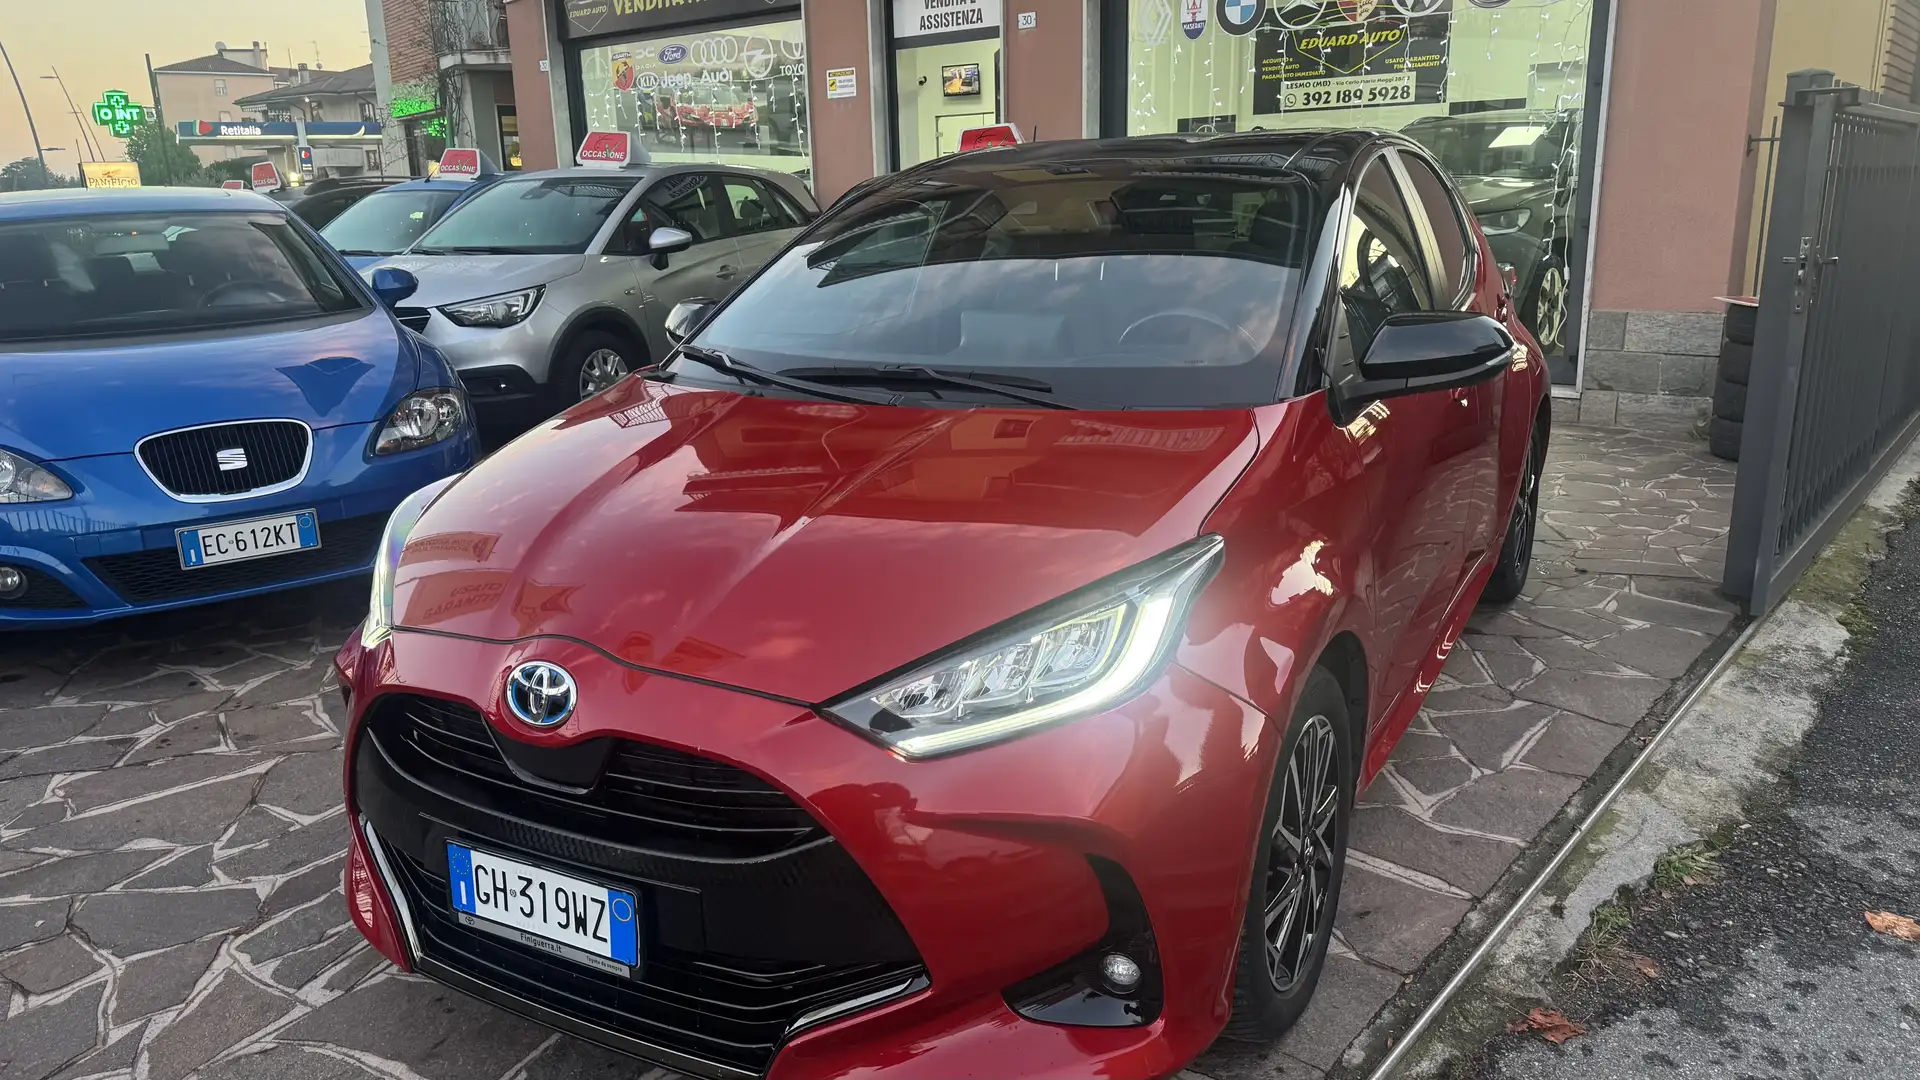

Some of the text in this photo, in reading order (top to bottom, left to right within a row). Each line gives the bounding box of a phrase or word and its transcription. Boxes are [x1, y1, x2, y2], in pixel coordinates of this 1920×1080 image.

[569, 5, 607, 18] EDUARD AUTO
[920, 8, 983, 31] ASSISTENZA
[1022, 15, 1032, 26] 30
[1183, 22, 1205, 30] MASERATI
[1300, 29, 1401, 50] EDUARD AUTO
[663, 47, 682, 62] Ford
[1405, 54, 1440, 62] ARANTITO
[635, 63, 657, 71] DACIA
[1393, 61, 1440, 69] FINZIAMENTI
[661, 70, 691, 89] Jeep
[700, 68, 733, 84] Audi
[1295, 70, 1326, 78] IMMEDIATO
[639, 76, 657, 87] KIA
[1286, 81, 1311, 90] LESMO
[1312, 80, 1331, 88] (MB)
[1377, 76, 1394, 84] Maggi
[1302, 85, 1411, 106] 392 189 5928
[100, 108, 140, 121] O INT
[220, 125, 261, 136] Retitalia
[449, 582, 503, 597] USATO
[520, 932, 562, 954] Finiguerra.it
[586, 955, 600, 965] Toyota
